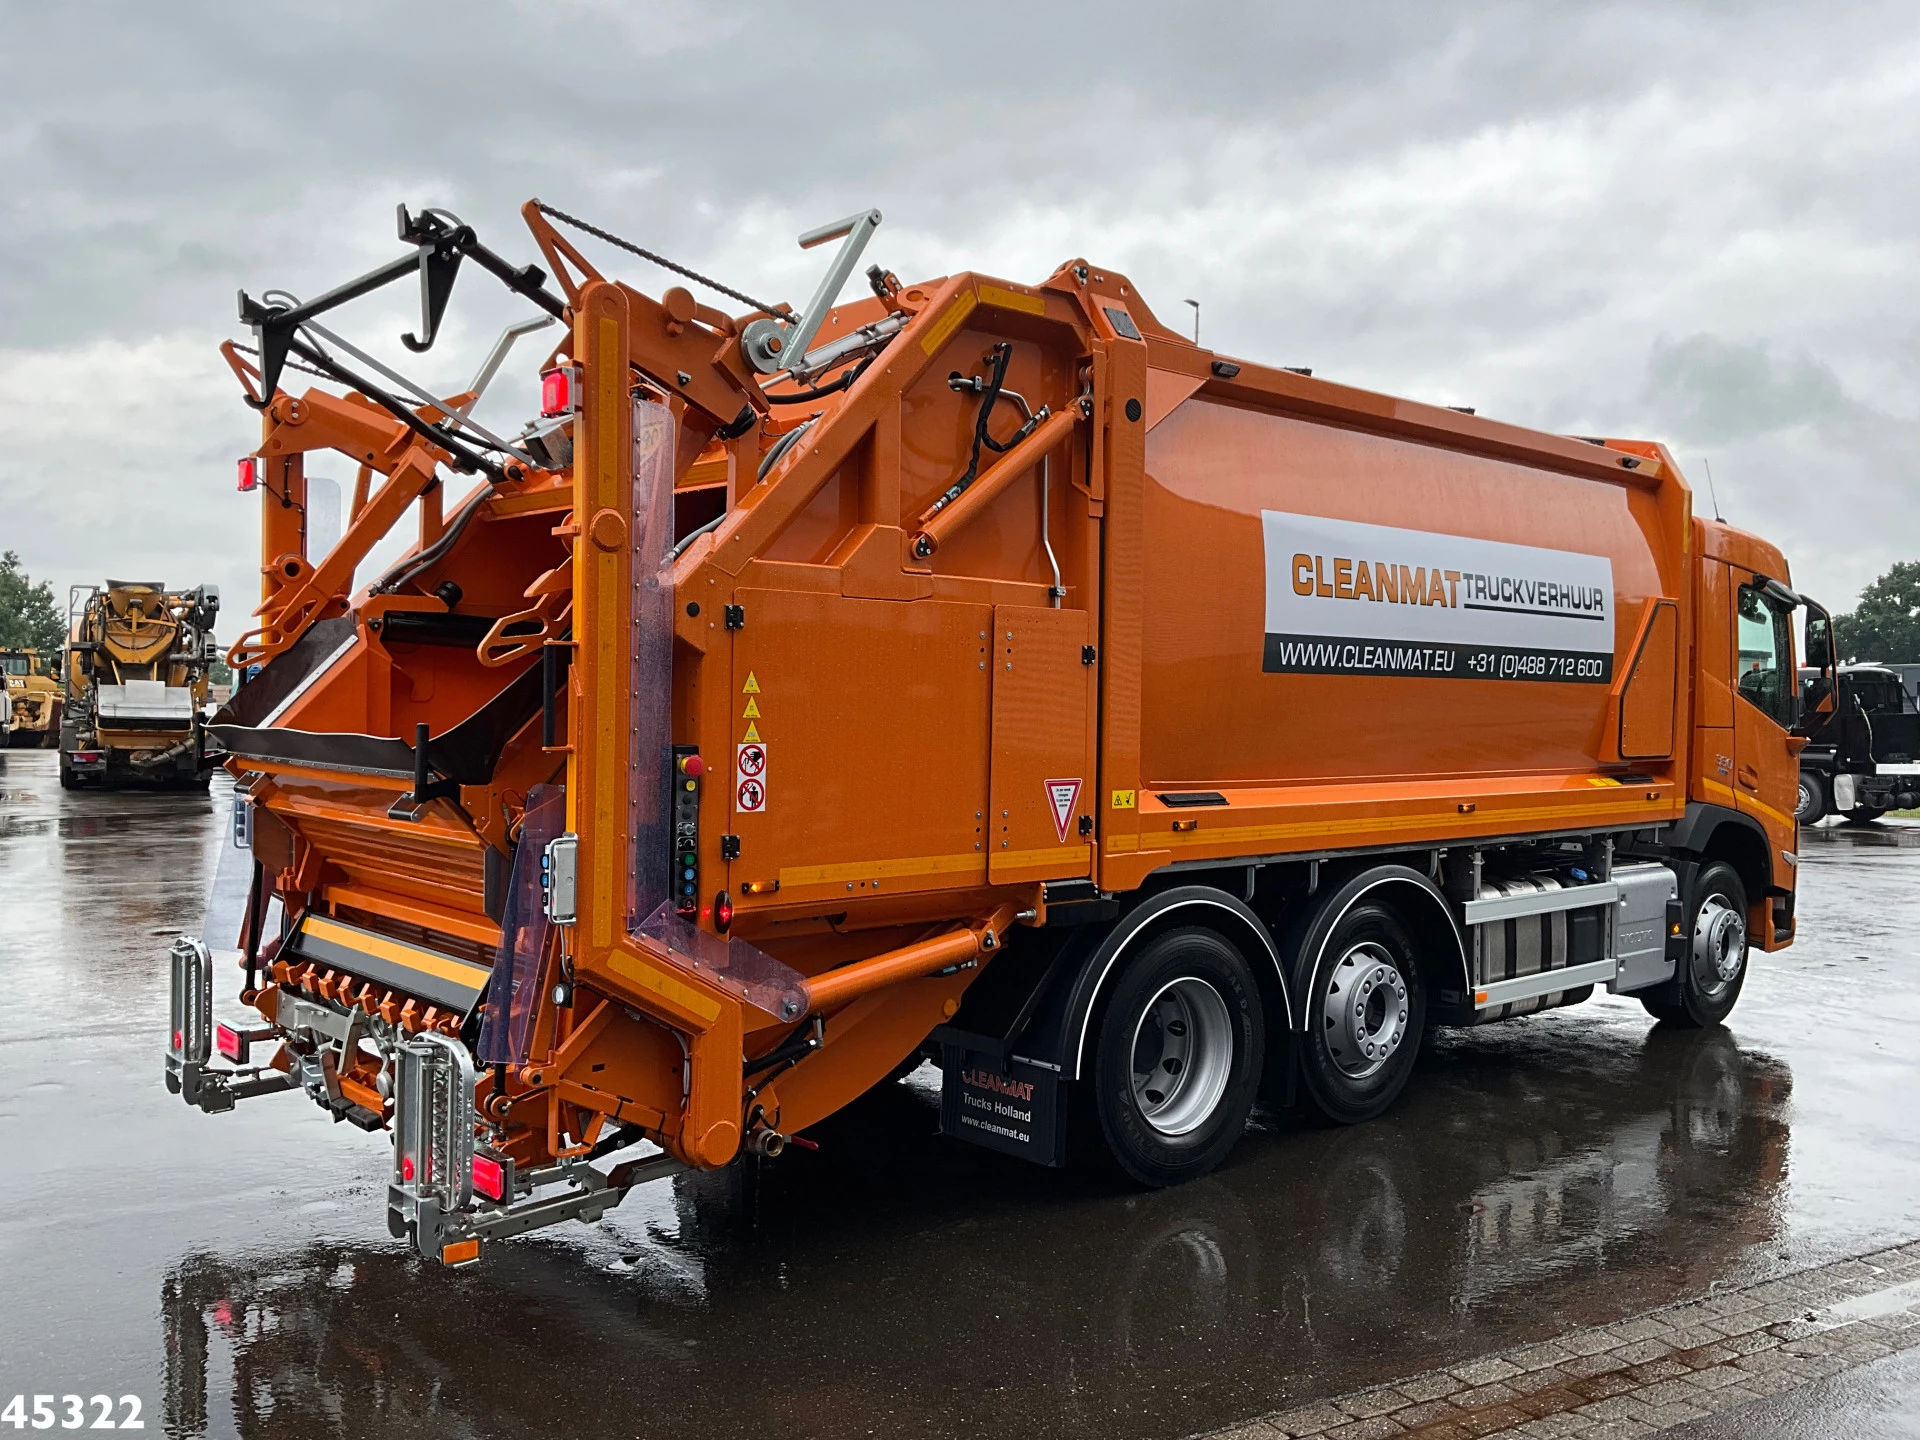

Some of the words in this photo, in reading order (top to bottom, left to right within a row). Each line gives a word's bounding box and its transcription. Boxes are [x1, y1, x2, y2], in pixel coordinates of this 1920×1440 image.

[1291, 553, 1461, 609] CLEANMAT
[1463, 573, 1604, 612] TRUCKVERHUUR
[1279, 642, 1456, 673] WWW.CLEANMAT.EU
[1467, 654, 1496, 674] +31
[1499, 654, 1546, 678] (0)488
[1549, 657, 1575, 677] 712
[1577, 659, 1603, 678] 600
[9, 679, 26, 688] CAT
[962, 1069, 1034, 1102] CLEANMAT
[963, 1092, 992, 1111] Trucks
[994, 1101, 1031, 1122] Holland
[961, 1114, 1030, 1143] www.cleanmat.eu
